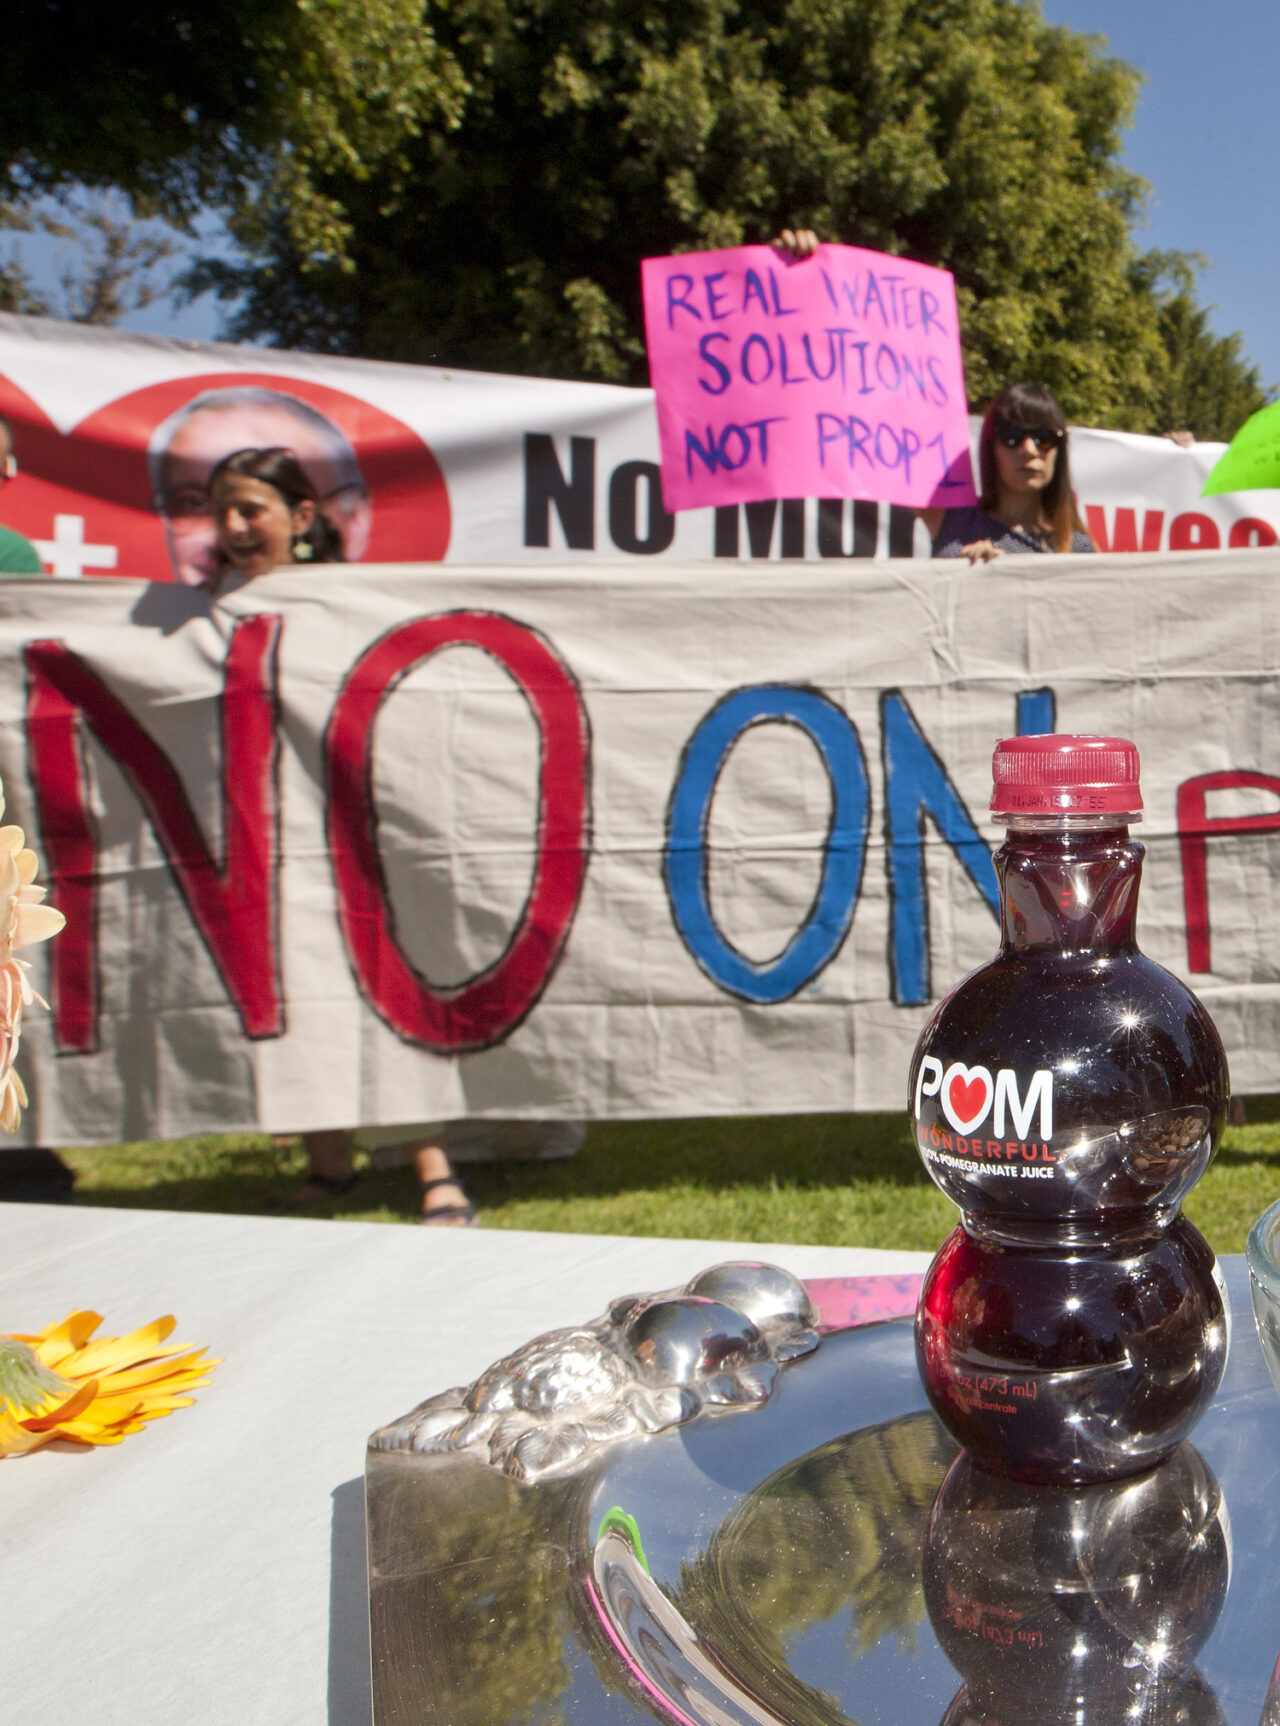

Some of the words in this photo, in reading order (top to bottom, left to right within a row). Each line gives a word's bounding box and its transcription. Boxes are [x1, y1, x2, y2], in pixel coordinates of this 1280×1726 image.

[665, 267, 799, 330] REAL
[821, 266, 948, 337] WATER
[697, 328, 949, 408] SOLUTIONS
[684, 415, 792, 481] NOT
[23, 608, 593, 1056] NO
[663, 682, 1057, 1008] ON
[914, 1054, 1054, 1141] POM
[918, 1125, 1057, 1162] WONDERFUL
[938, 1153, 1019, 1179] POMEGRANATE
[1020, 1165, 1056, 1180] JUICE
[1011, 1379, 1038, 1401] mL)
